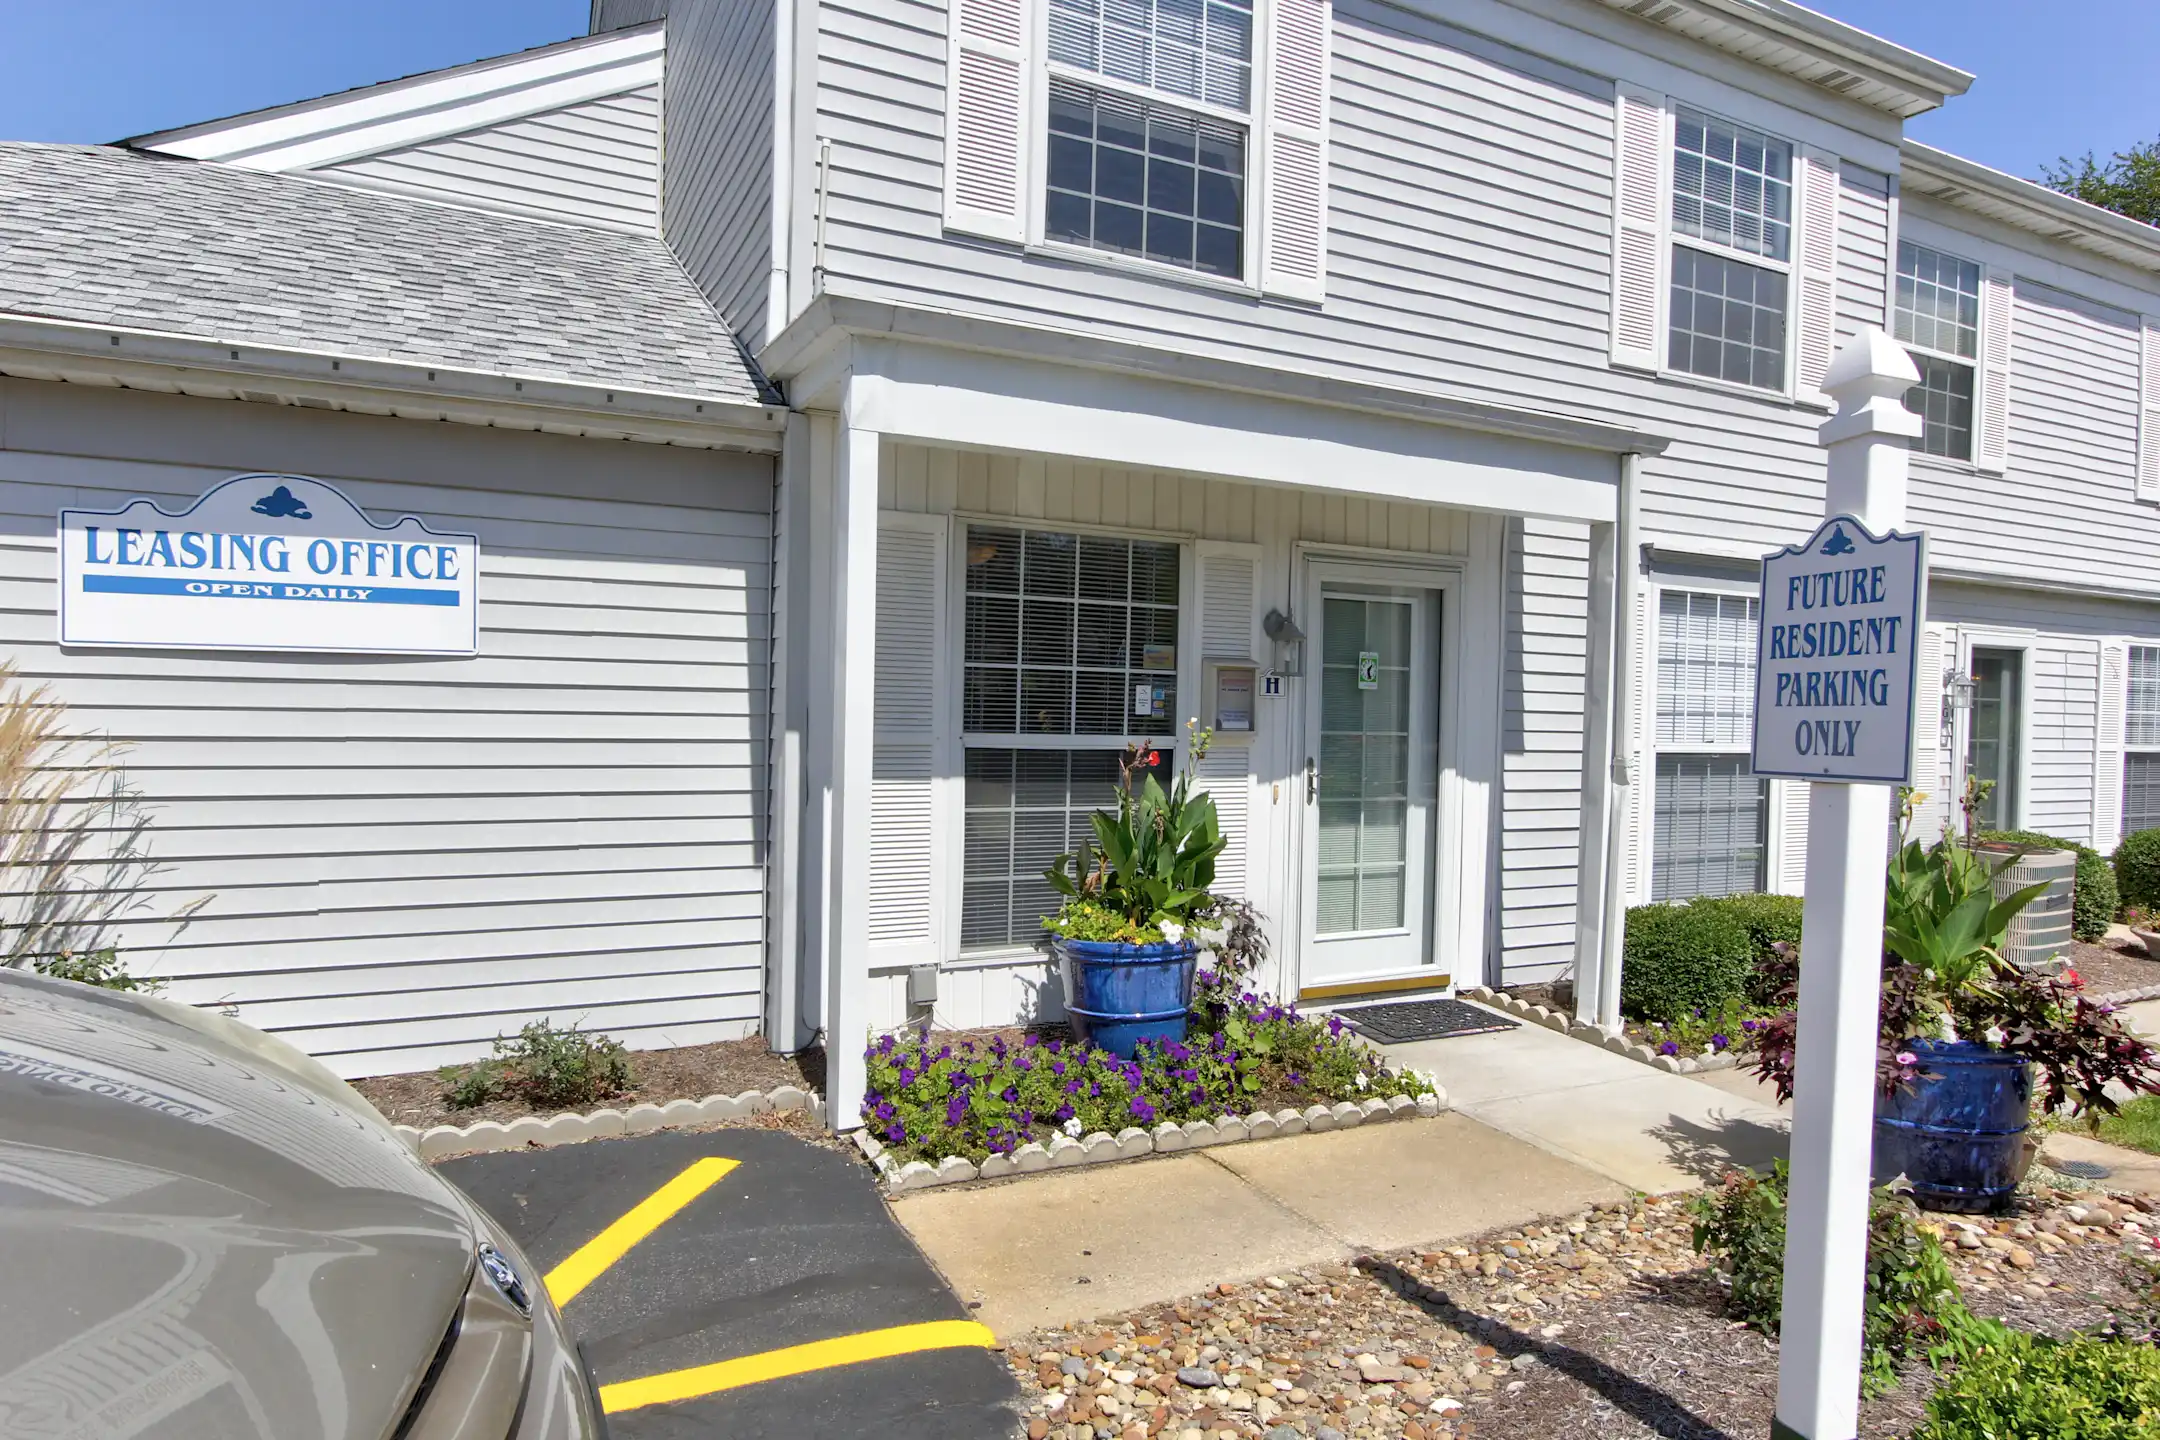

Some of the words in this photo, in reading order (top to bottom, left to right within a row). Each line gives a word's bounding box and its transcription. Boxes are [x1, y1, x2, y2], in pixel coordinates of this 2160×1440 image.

[84, 525, 291, 573] LEASING
[306, 538, 461, 581] OFFICE
[184, 581, 274, 598] OPEN
[284, 584, 374, 601] DAILY
[1787, 565, 1887, 611] FUTURE
[1769, 616, 1902, 660] RESIDENT
[1265, 677, 1280, 694] H
[1774, 668, 1889, 708] PARKING
[1794, 719, 1862, 757] ONLY
